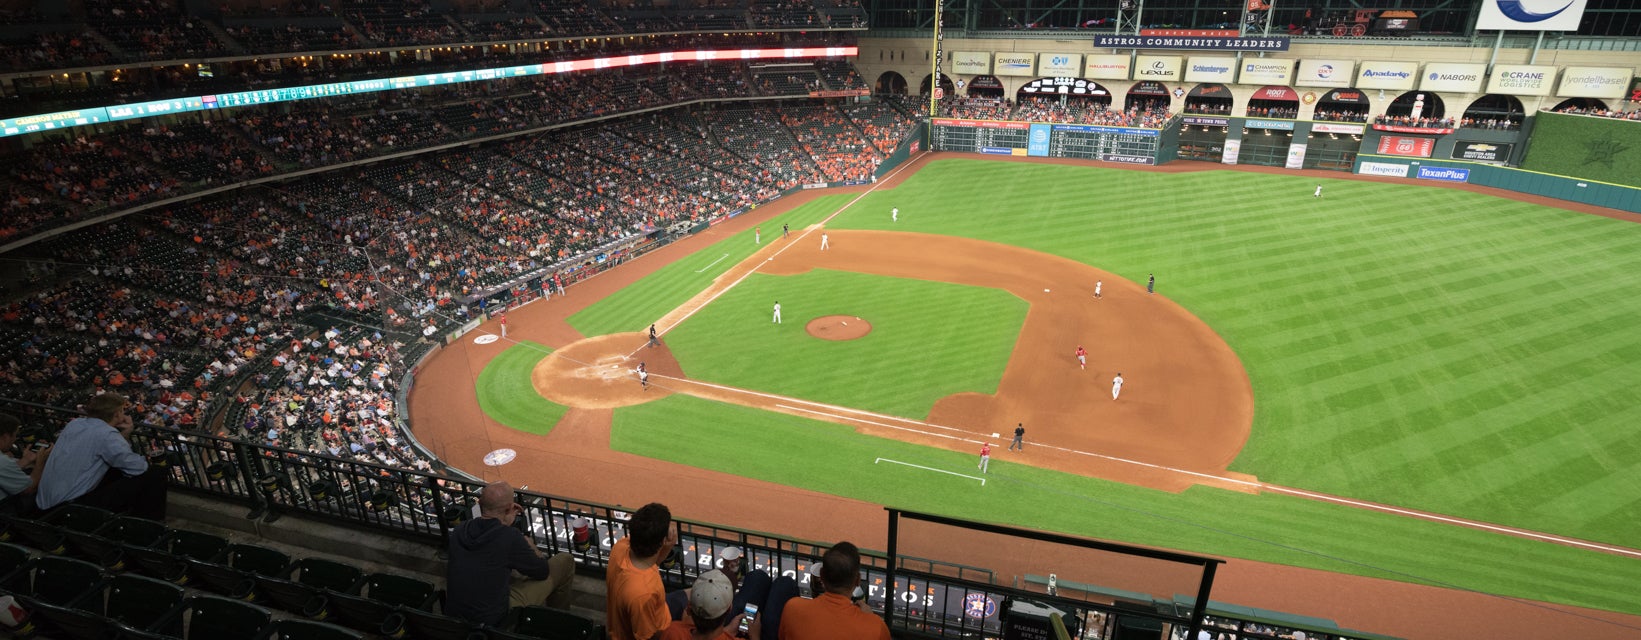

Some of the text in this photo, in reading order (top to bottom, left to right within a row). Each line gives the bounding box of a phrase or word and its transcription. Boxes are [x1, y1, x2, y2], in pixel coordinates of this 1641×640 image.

[1100, 37, 1283, 48] ASTROS COMMUNITY LEADERS
[1192, 65, 1229, 74] Schlumberger
[1362, 69, 1410, 79] Anadarko
[1440, 73, 1477, 82] NABORS
[1509, 72, 1545, 80] CRANE
[1565, 75, 1628, 85] lyondellbasell
[1421, 168, 1466, 179] TexanPlus
